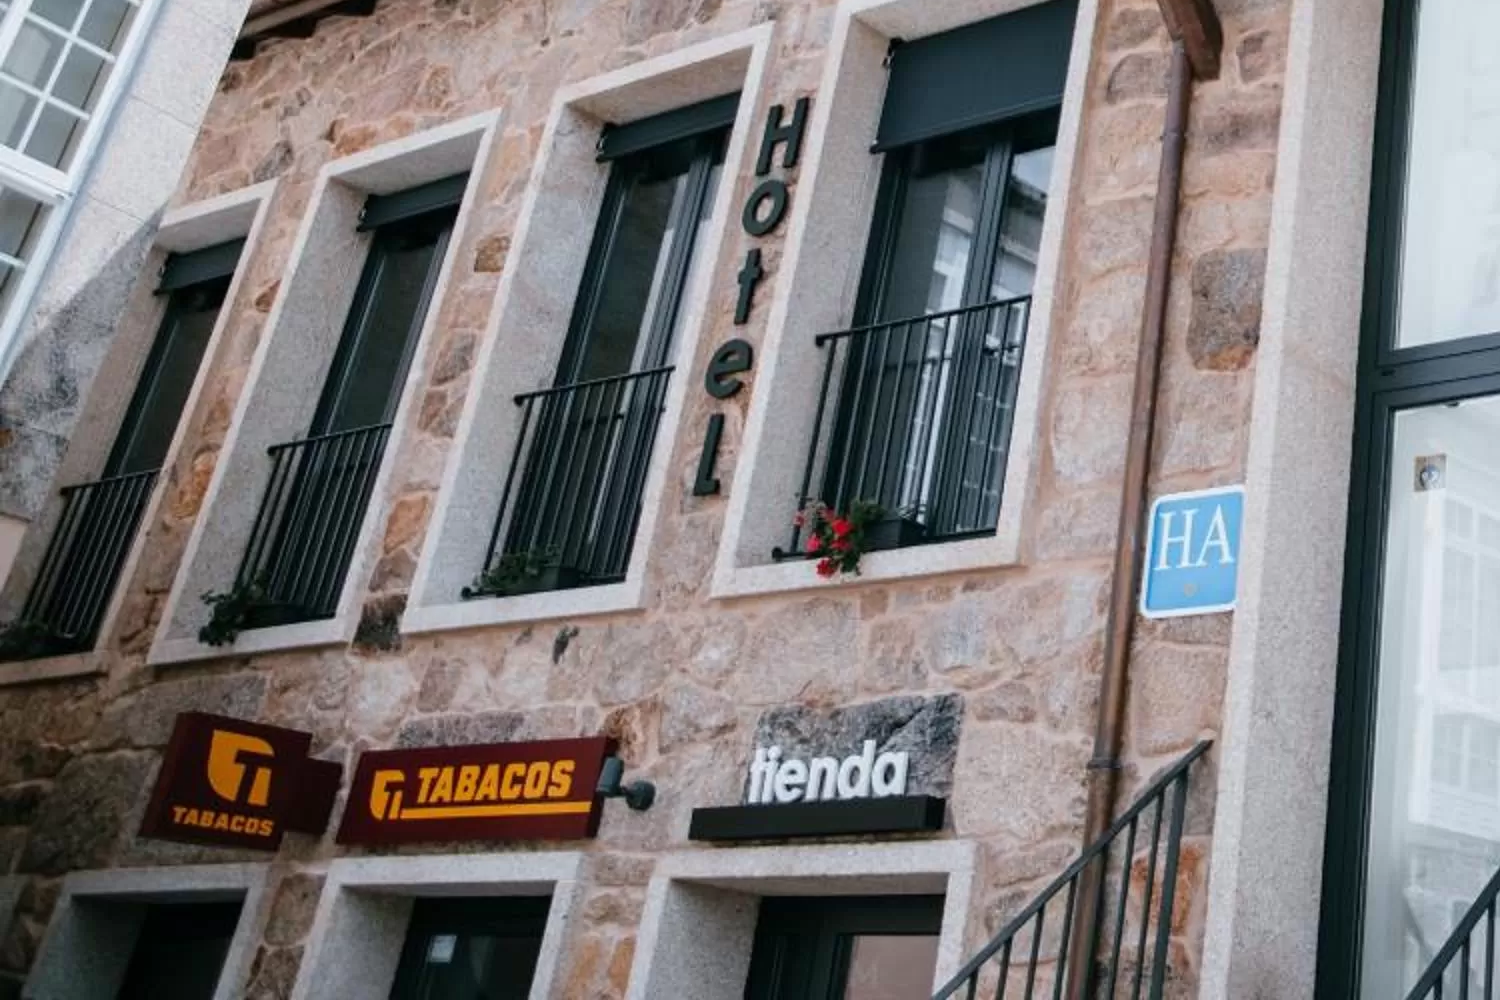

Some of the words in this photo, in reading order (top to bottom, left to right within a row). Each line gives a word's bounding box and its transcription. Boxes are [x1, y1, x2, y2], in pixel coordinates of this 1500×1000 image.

[1152, 503, 1235, 571] HA
[416, 759, 576, 804] TABACOS
[748, 739, 909, 804] tienda
[173, 805, 274, 837] TABACOS
